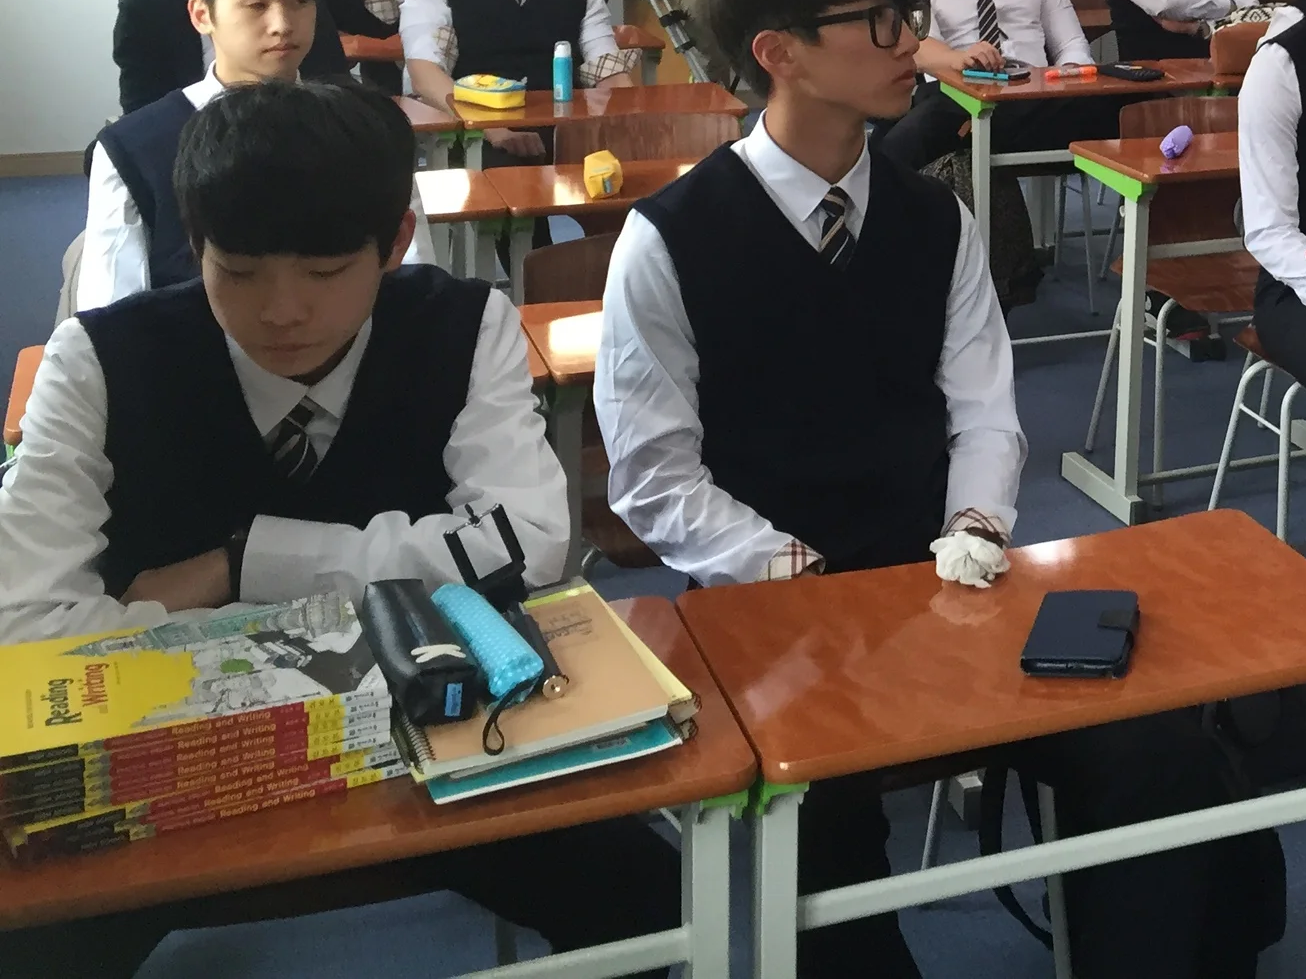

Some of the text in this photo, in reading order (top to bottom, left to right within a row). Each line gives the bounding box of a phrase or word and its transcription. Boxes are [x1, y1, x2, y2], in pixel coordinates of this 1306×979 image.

[78, 662, 109, 707] Writing
[40, 677, 83, 726] Reading
[172, 711, 271, 735] Reading and Writing
[177, 735, 218, 749] Reading
[222, 730, 240, 741] and
[243, 723, 276, 735] Writing
[176, 748, 216, 761] Reading
[220, 741, 238, 753] and
[241, 736, 275, 747] Writing
[178, 761, 217, 775] Reading
[220, 755, 239, 766] and
[242, 748, 276, 760] Writing
[177, 775, 216, 789] Reading
[220, 768, 238, 780] and
[241, 761, 275, 775] Writing
[214, 764, 309, 793] Reading and Writing
[204, 792, 242, 807] Reading
[246, 785, 264, 797] and
[266, 777, 299, 791] Writing
[220, 789, 316, 818] Reading and Writing
